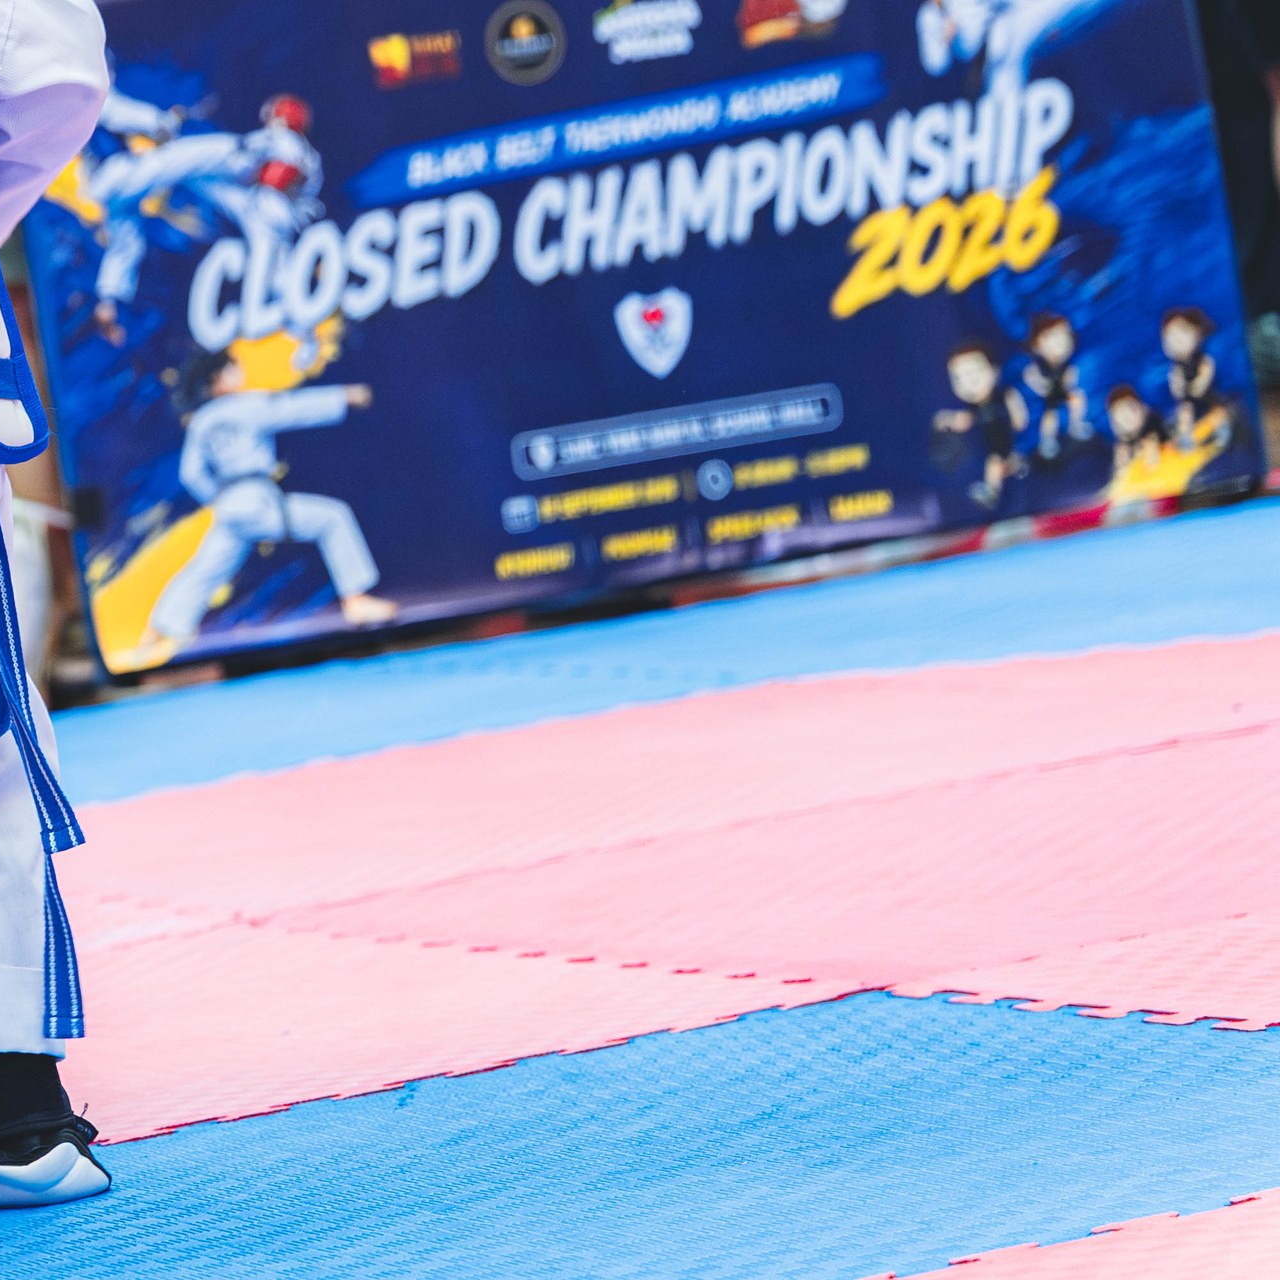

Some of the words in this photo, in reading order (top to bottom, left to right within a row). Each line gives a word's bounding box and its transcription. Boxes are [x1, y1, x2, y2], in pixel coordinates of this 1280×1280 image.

[187, 192, 501, 354] CLOSED
[513, 77, 1075, 286] CHAMPIONSHIP
[828, 166, 1059, 320] 2026
